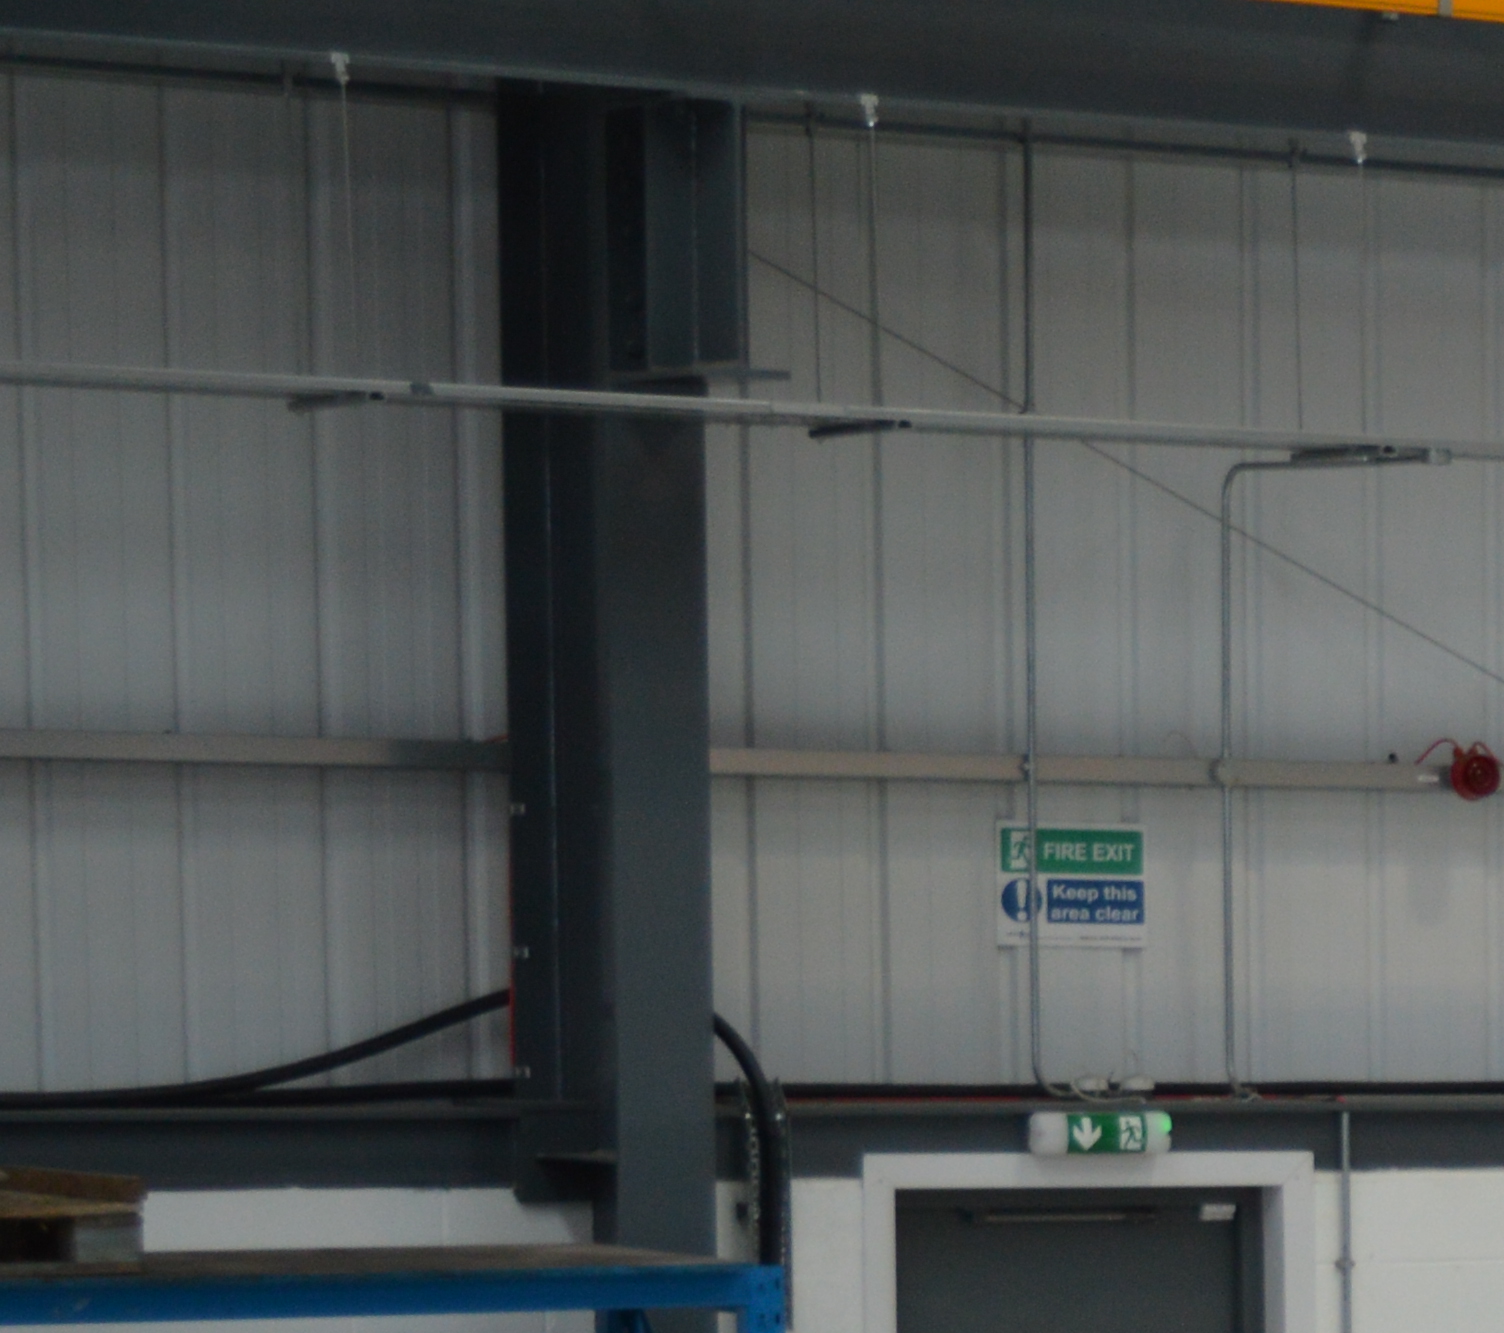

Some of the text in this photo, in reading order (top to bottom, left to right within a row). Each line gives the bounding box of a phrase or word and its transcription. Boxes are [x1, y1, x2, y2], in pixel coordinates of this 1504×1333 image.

[1043, 842, 1135, 862] FIRE EXIT
[1053, 885, 1137, 903] Keep this
[1051, 906, 1139, 922] area clear
